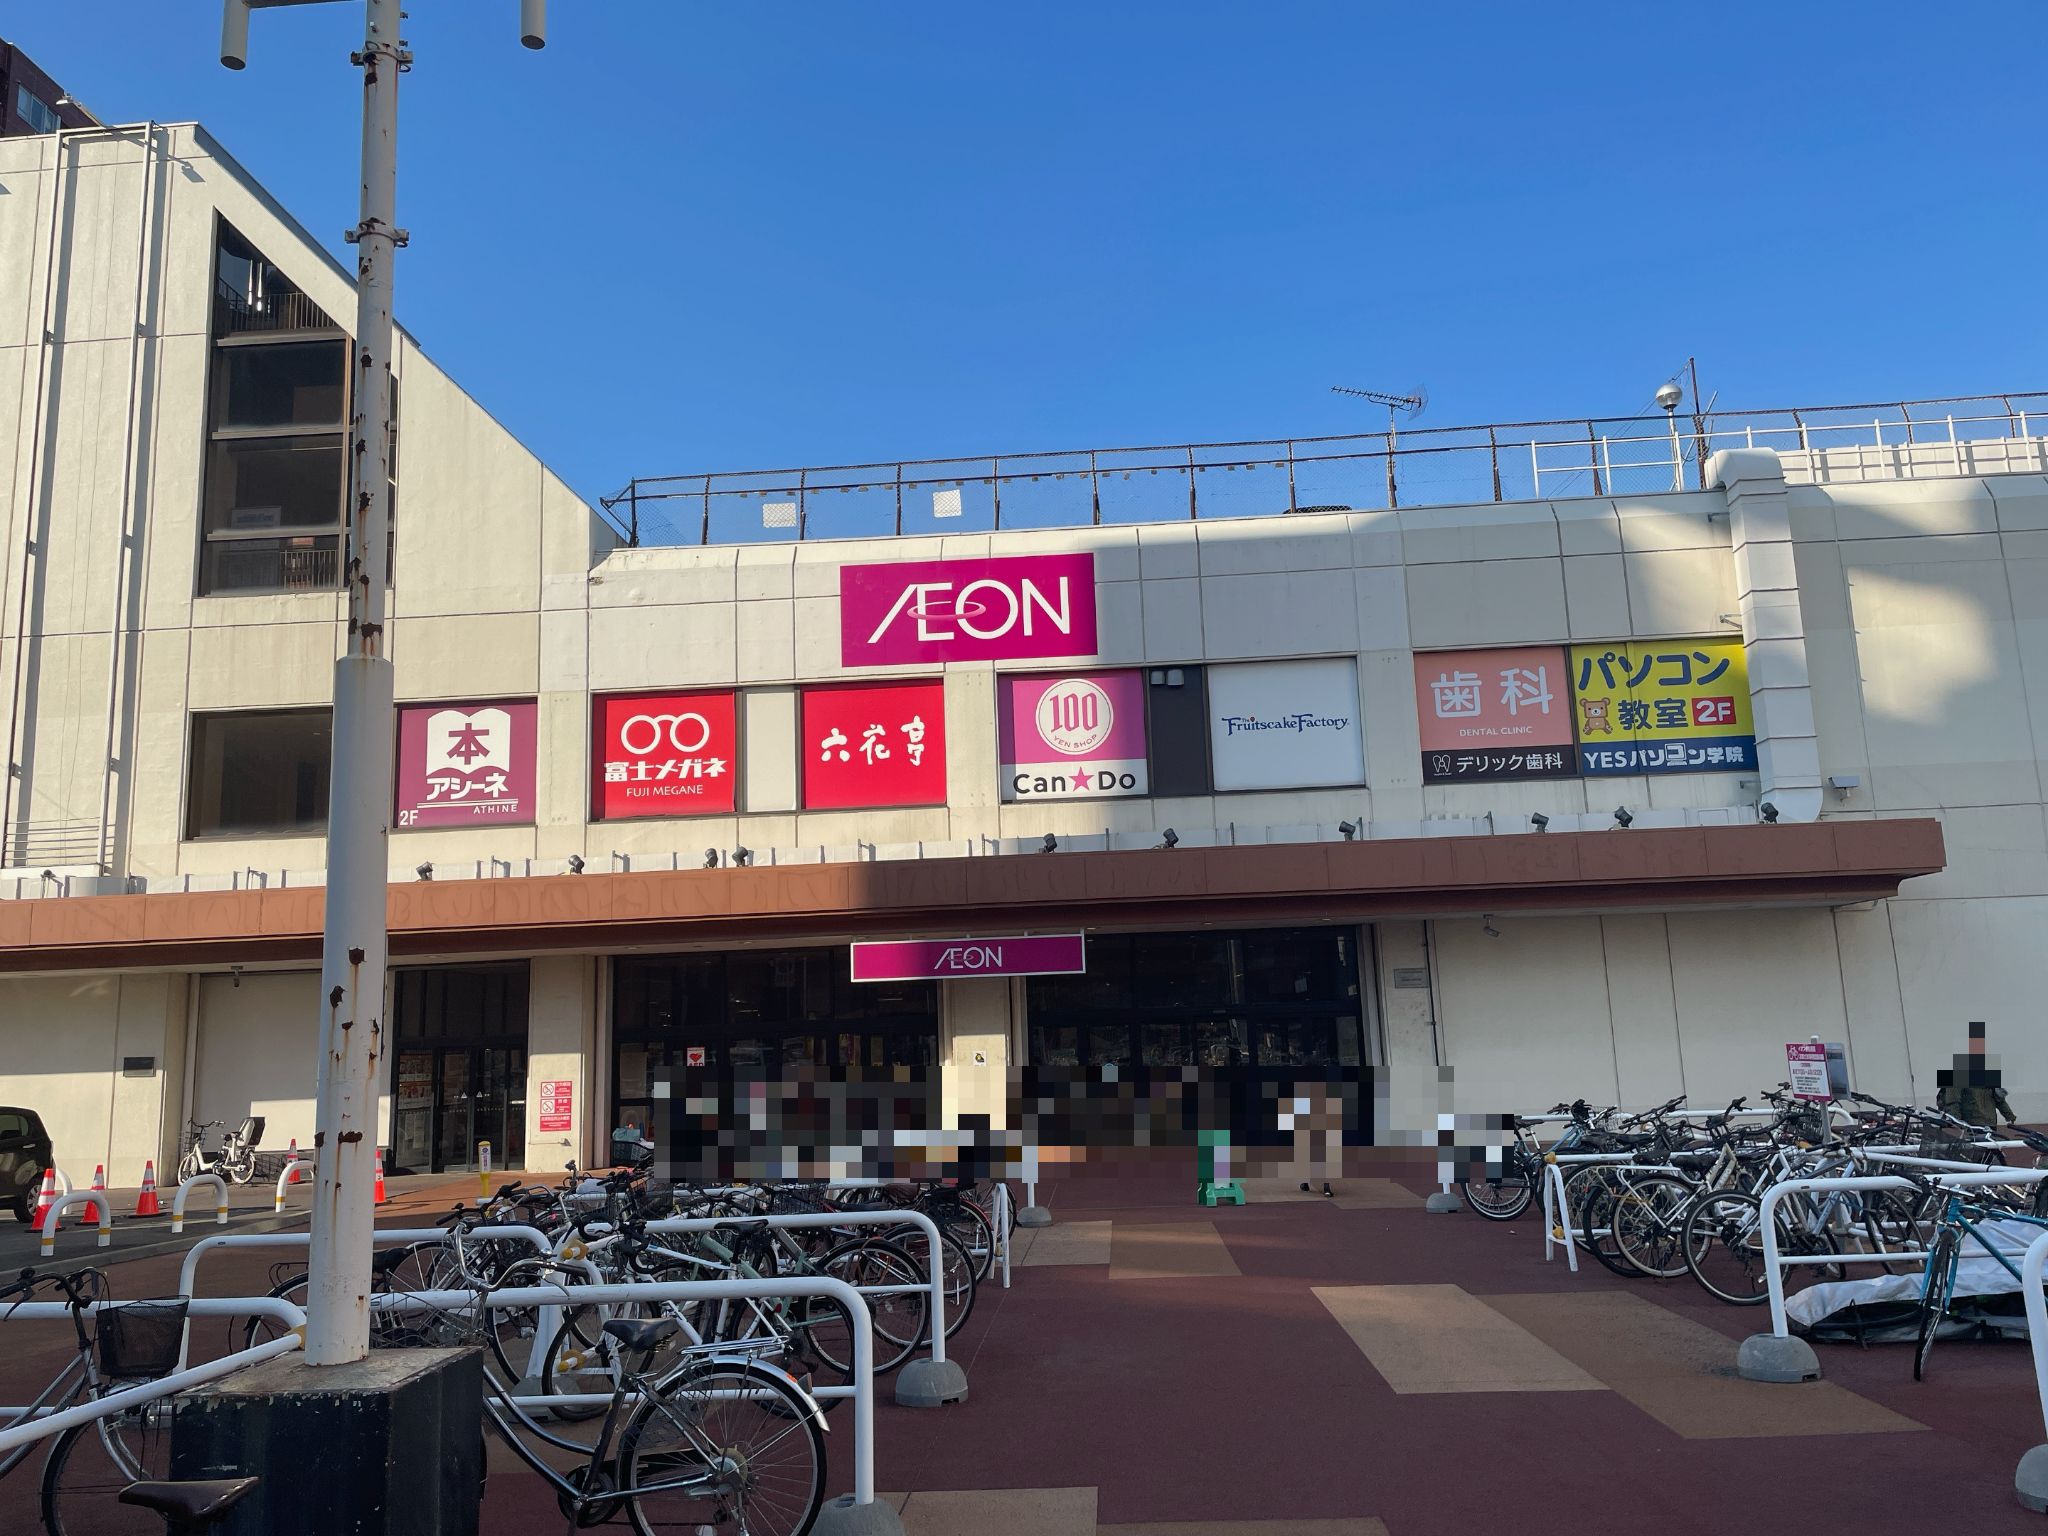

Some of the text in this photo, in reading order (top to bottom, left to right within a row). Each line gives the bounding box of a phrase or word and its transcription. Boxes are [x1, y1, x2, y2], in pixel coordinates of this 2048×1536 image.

[1578, 651, 1730, 690] パソコン
[1430, 665, 1553, 718] 歯科
[1049, 692, 1098, 732] 100
[1618, 698, 1731, 730] 教室 2F
[1221, 714, 1348, 736] Fruitscake Factory
[1459, 726, 1533, 737] DENTAL CLINIC
[447, 723, 490, 765] 本
[820, 715, 925, 767] 六花亭
[1053, 734, 1097, 748] YEN SHOP
[604, 757, 728, 782] 富士メガネ
[1456, 752, 1563, 773] デリック歯科
[426, 772, 509, 800] アシーネ
[626, 785, 704, 797] FUJI MEGANE
[399, 809, 419, 826] 2F
[473, 804, 518, 814] ATHINE
